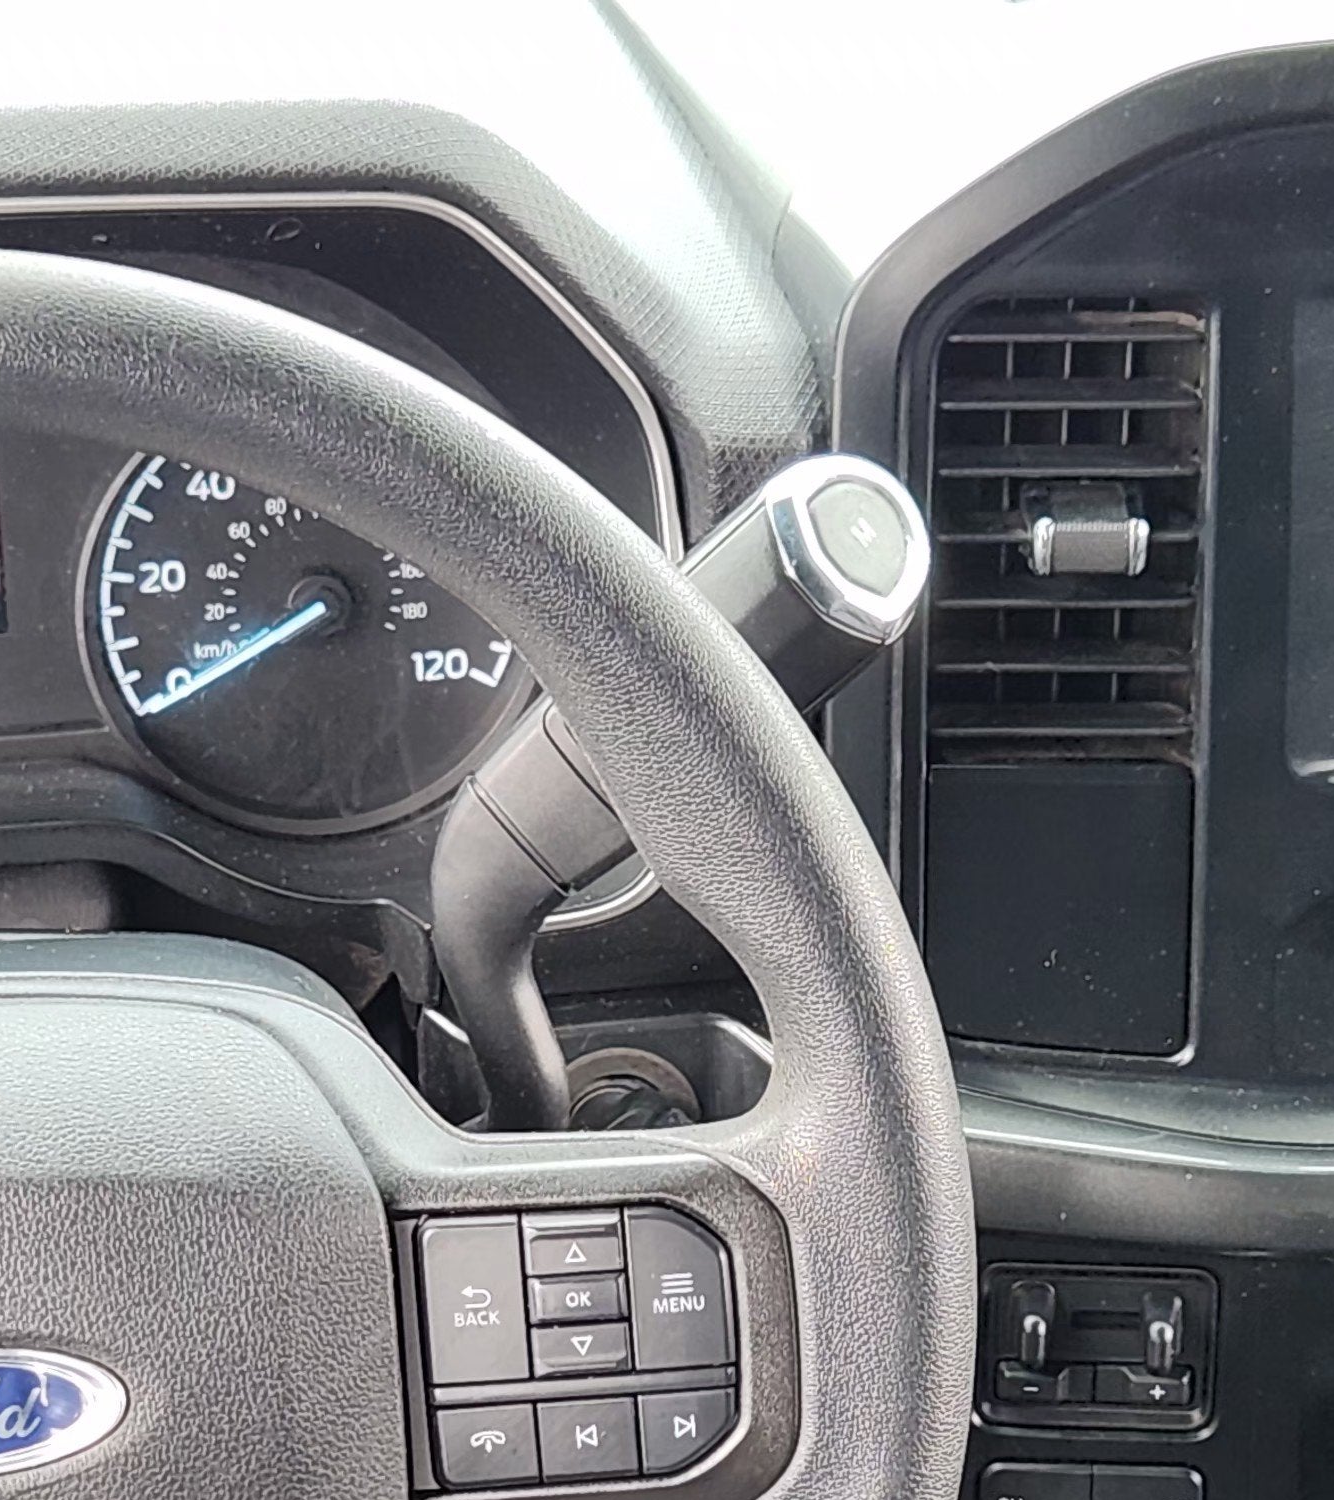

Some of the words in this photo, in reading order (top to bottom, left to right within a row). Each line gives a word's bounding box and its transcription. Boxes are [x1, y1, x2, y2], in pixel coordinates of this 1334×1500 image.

[186, 469, 236, 502] 40
[265, 498, 287, 516] 80
[228, 521, 250, 540] 60
[138, 560, 186, 594] 20
[206, 562, 228, 580] 40
[204, 604, 225, 621] 20
[401, 601, 428, 620] 180
[411, 649, 469, 682] 120
[565, 1291, 592, 1309] OK
[652, 1294, 705, 1315] MENU
[454, 1310, 500, 1328] BACK
